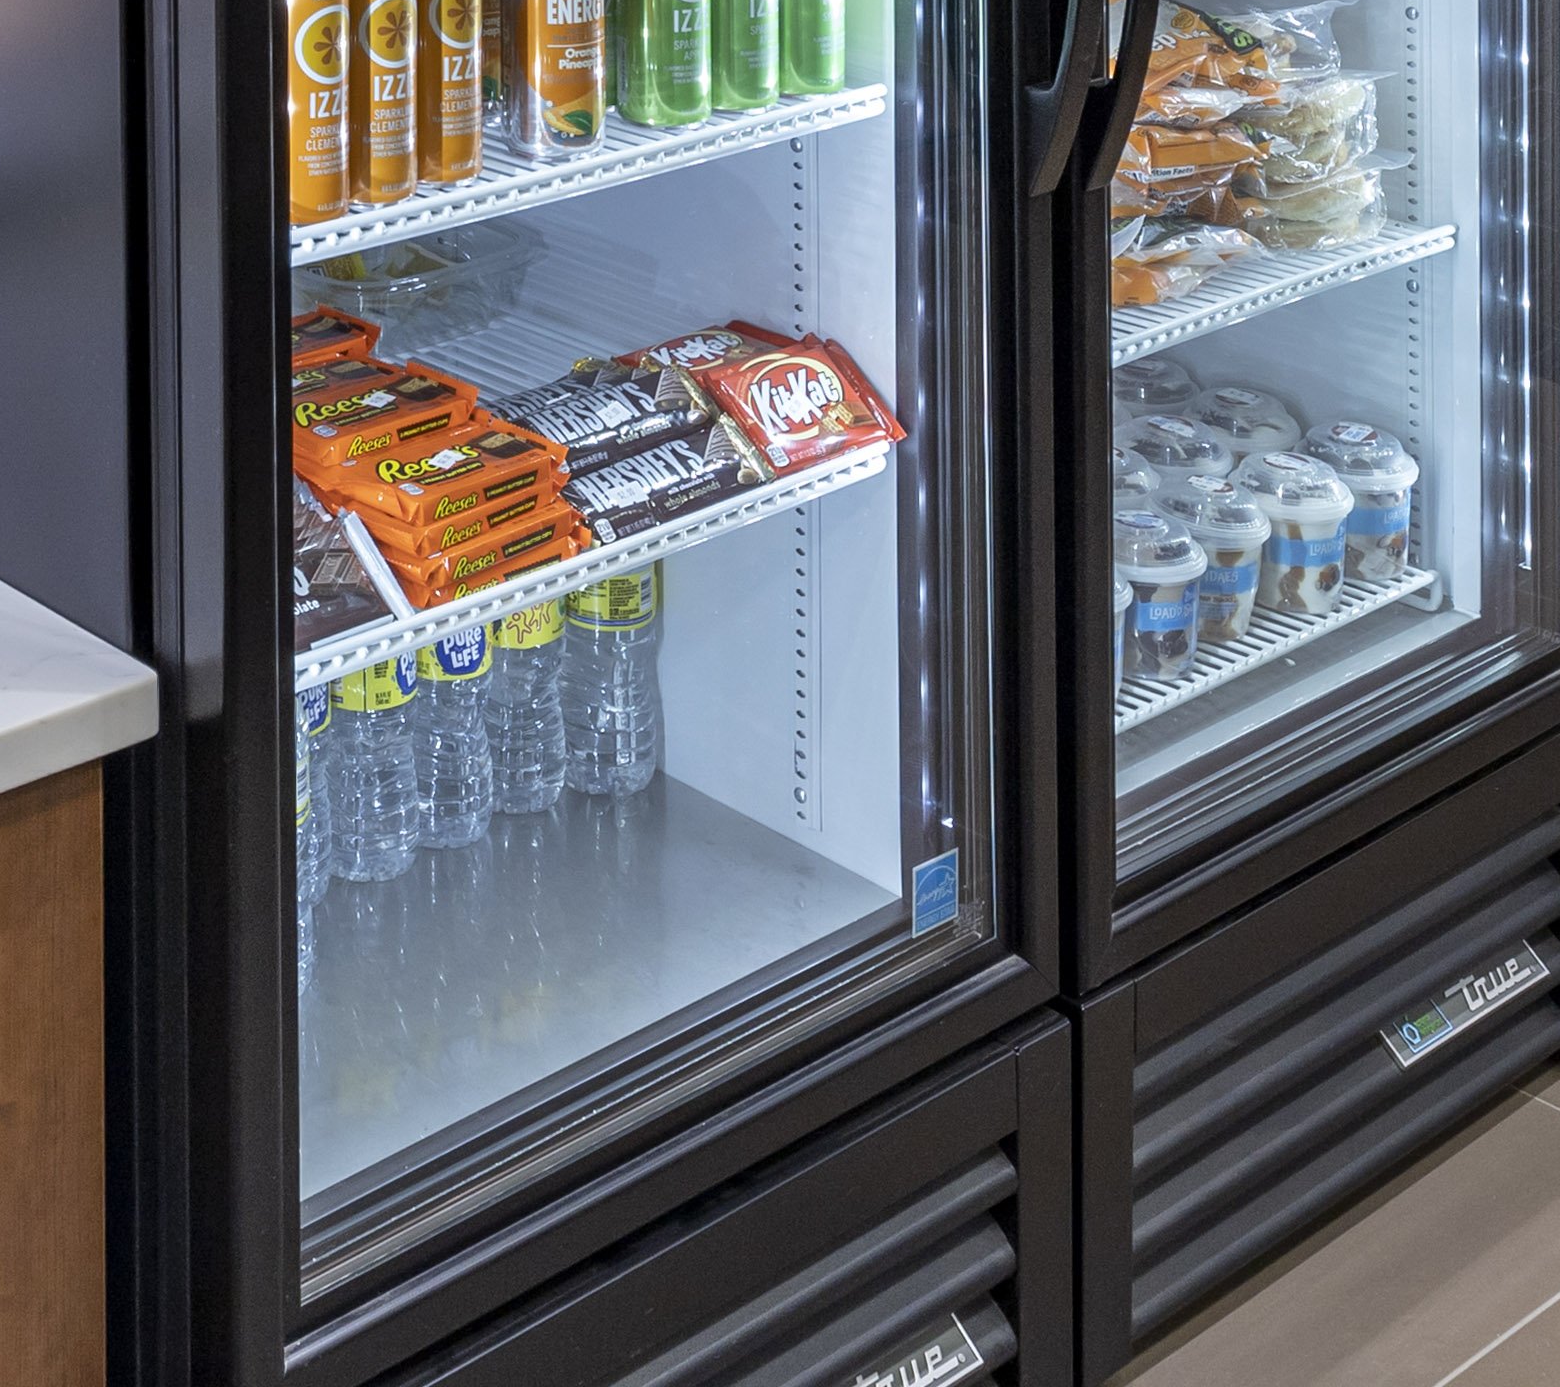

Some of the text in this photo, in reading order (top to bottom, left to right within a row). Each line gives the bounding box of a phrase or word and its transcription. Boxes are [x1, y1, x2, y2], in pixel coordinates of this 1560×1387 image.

[347, 433, 391, 458] Reese's
[580, 440, 705, 510] HERSHEY'S
[435, 493, 478, 519] Reese's
[442, 521, 482, 548] Reese's
[454, 551, 496, 580] Reese's
